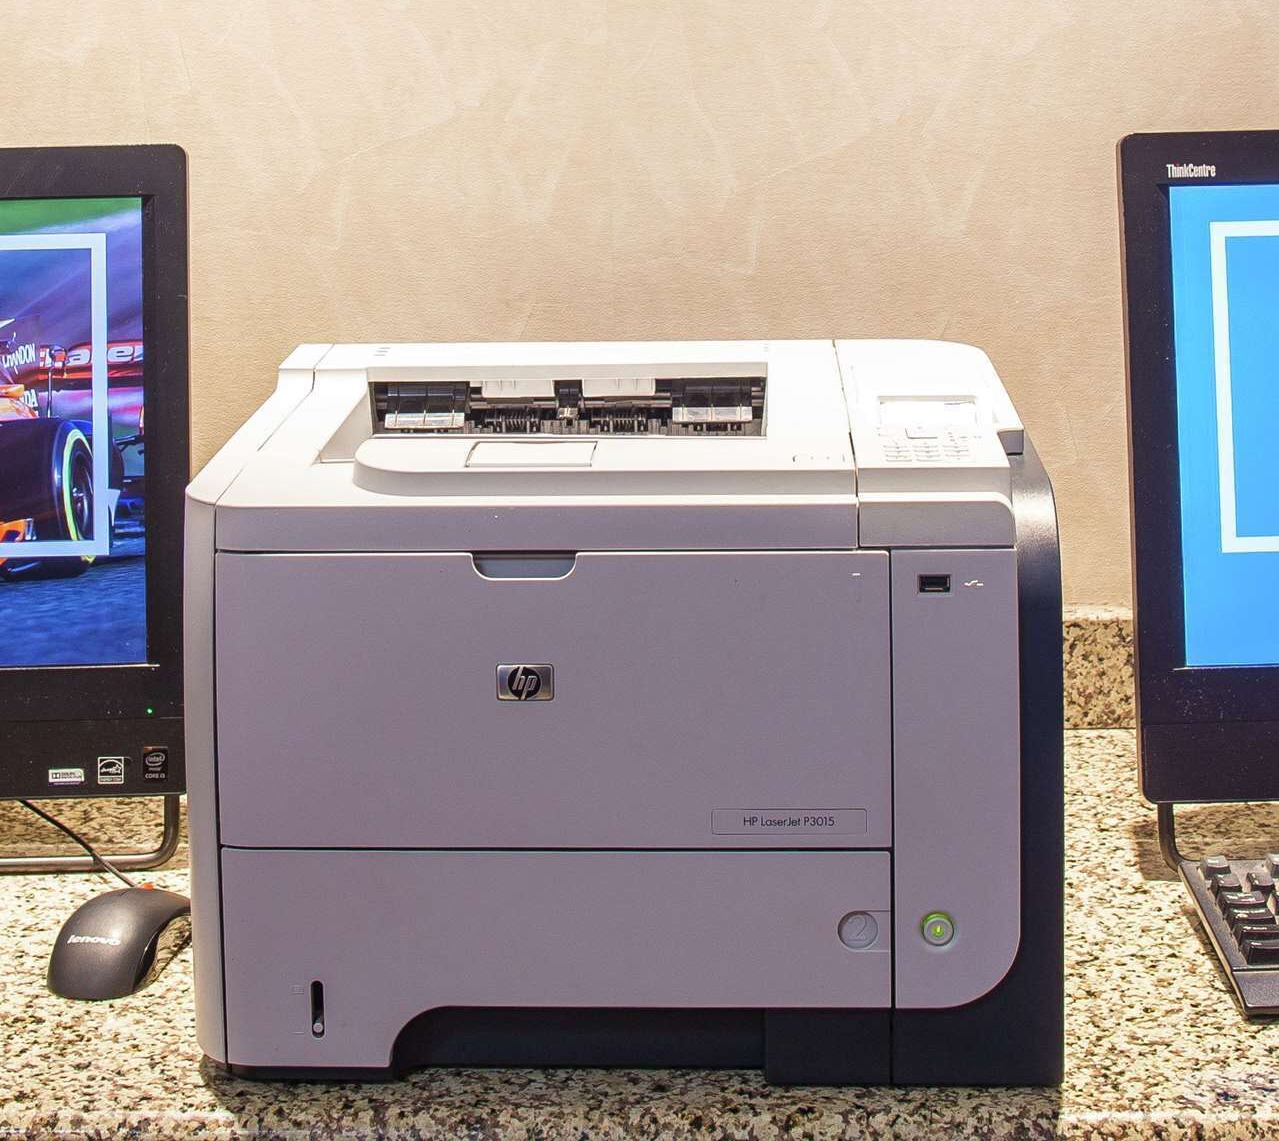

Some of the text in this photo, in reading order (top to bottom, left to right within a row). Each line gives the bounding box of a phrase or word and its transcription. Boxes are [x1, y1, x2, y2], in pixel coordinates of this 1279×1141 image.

[1166, 163, 1216, 178] ThinkCentre
[512, 665, 538, 700] hp
[743, 816, 835, 827] HP LaserJet P3015
[67, 934, 121, 945] lenovo
